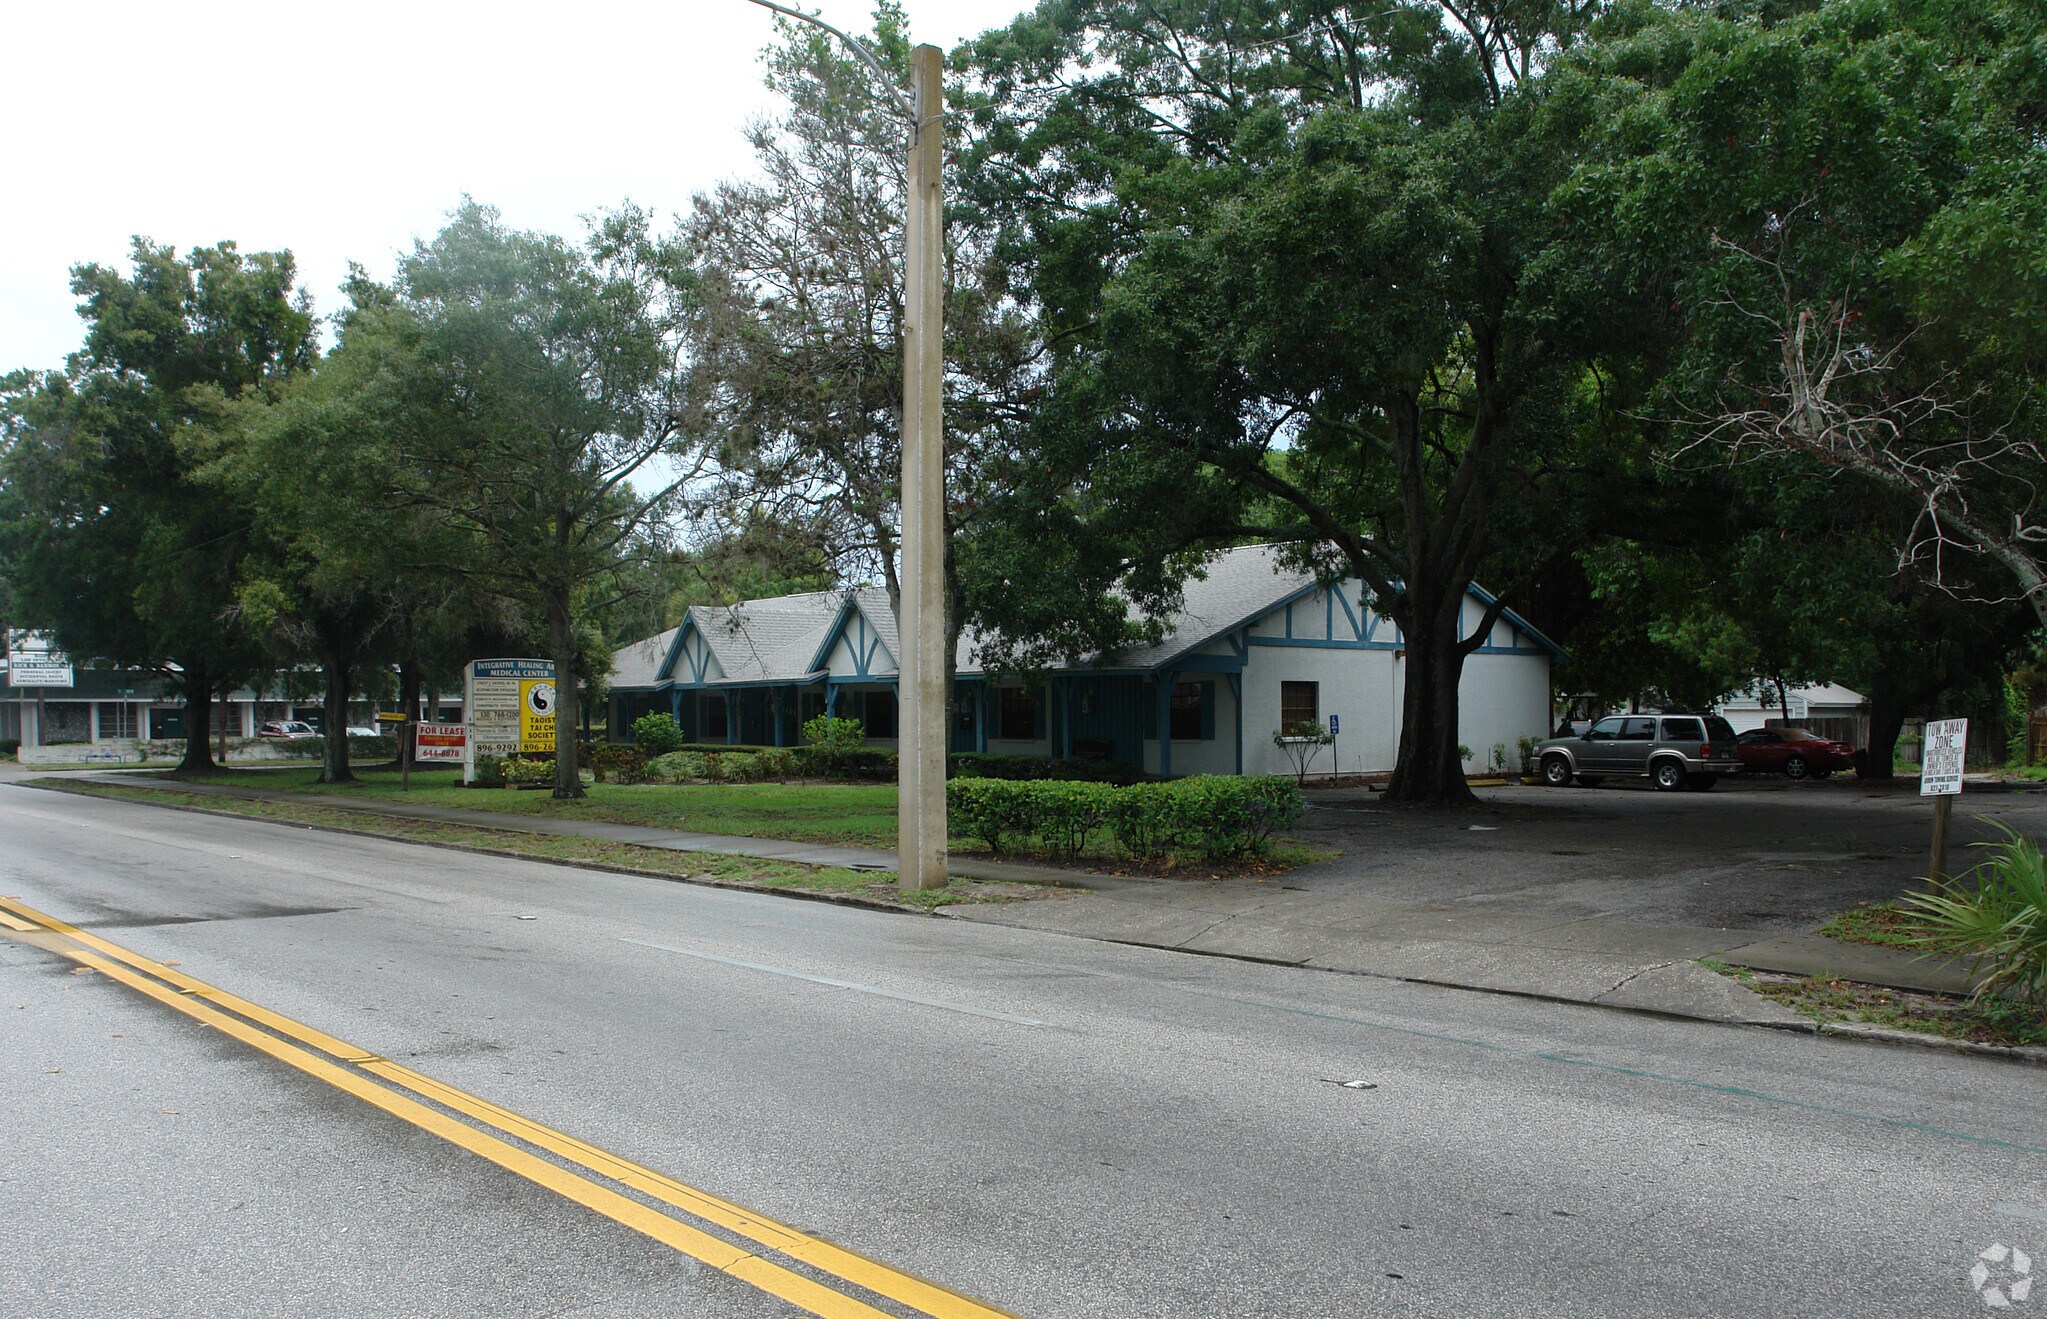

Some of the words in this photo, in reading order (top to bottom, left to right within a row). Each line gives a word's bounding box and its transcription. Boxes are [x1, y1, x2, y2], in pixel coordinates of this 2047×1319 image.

[477, 662, 514, 670] INTEGRATIVE
[518, 661, 543, 669] HEALING
[546, 662, 555, 670] AR
[440, 727, 465, 735] LEASE
[1928, 723, 1942, 737] TOW
[1944, 720, 1965, 735] AWAY
[1935, 735, 1953, 749] ZONE
[477, 744, 517, 752] 896-9292
